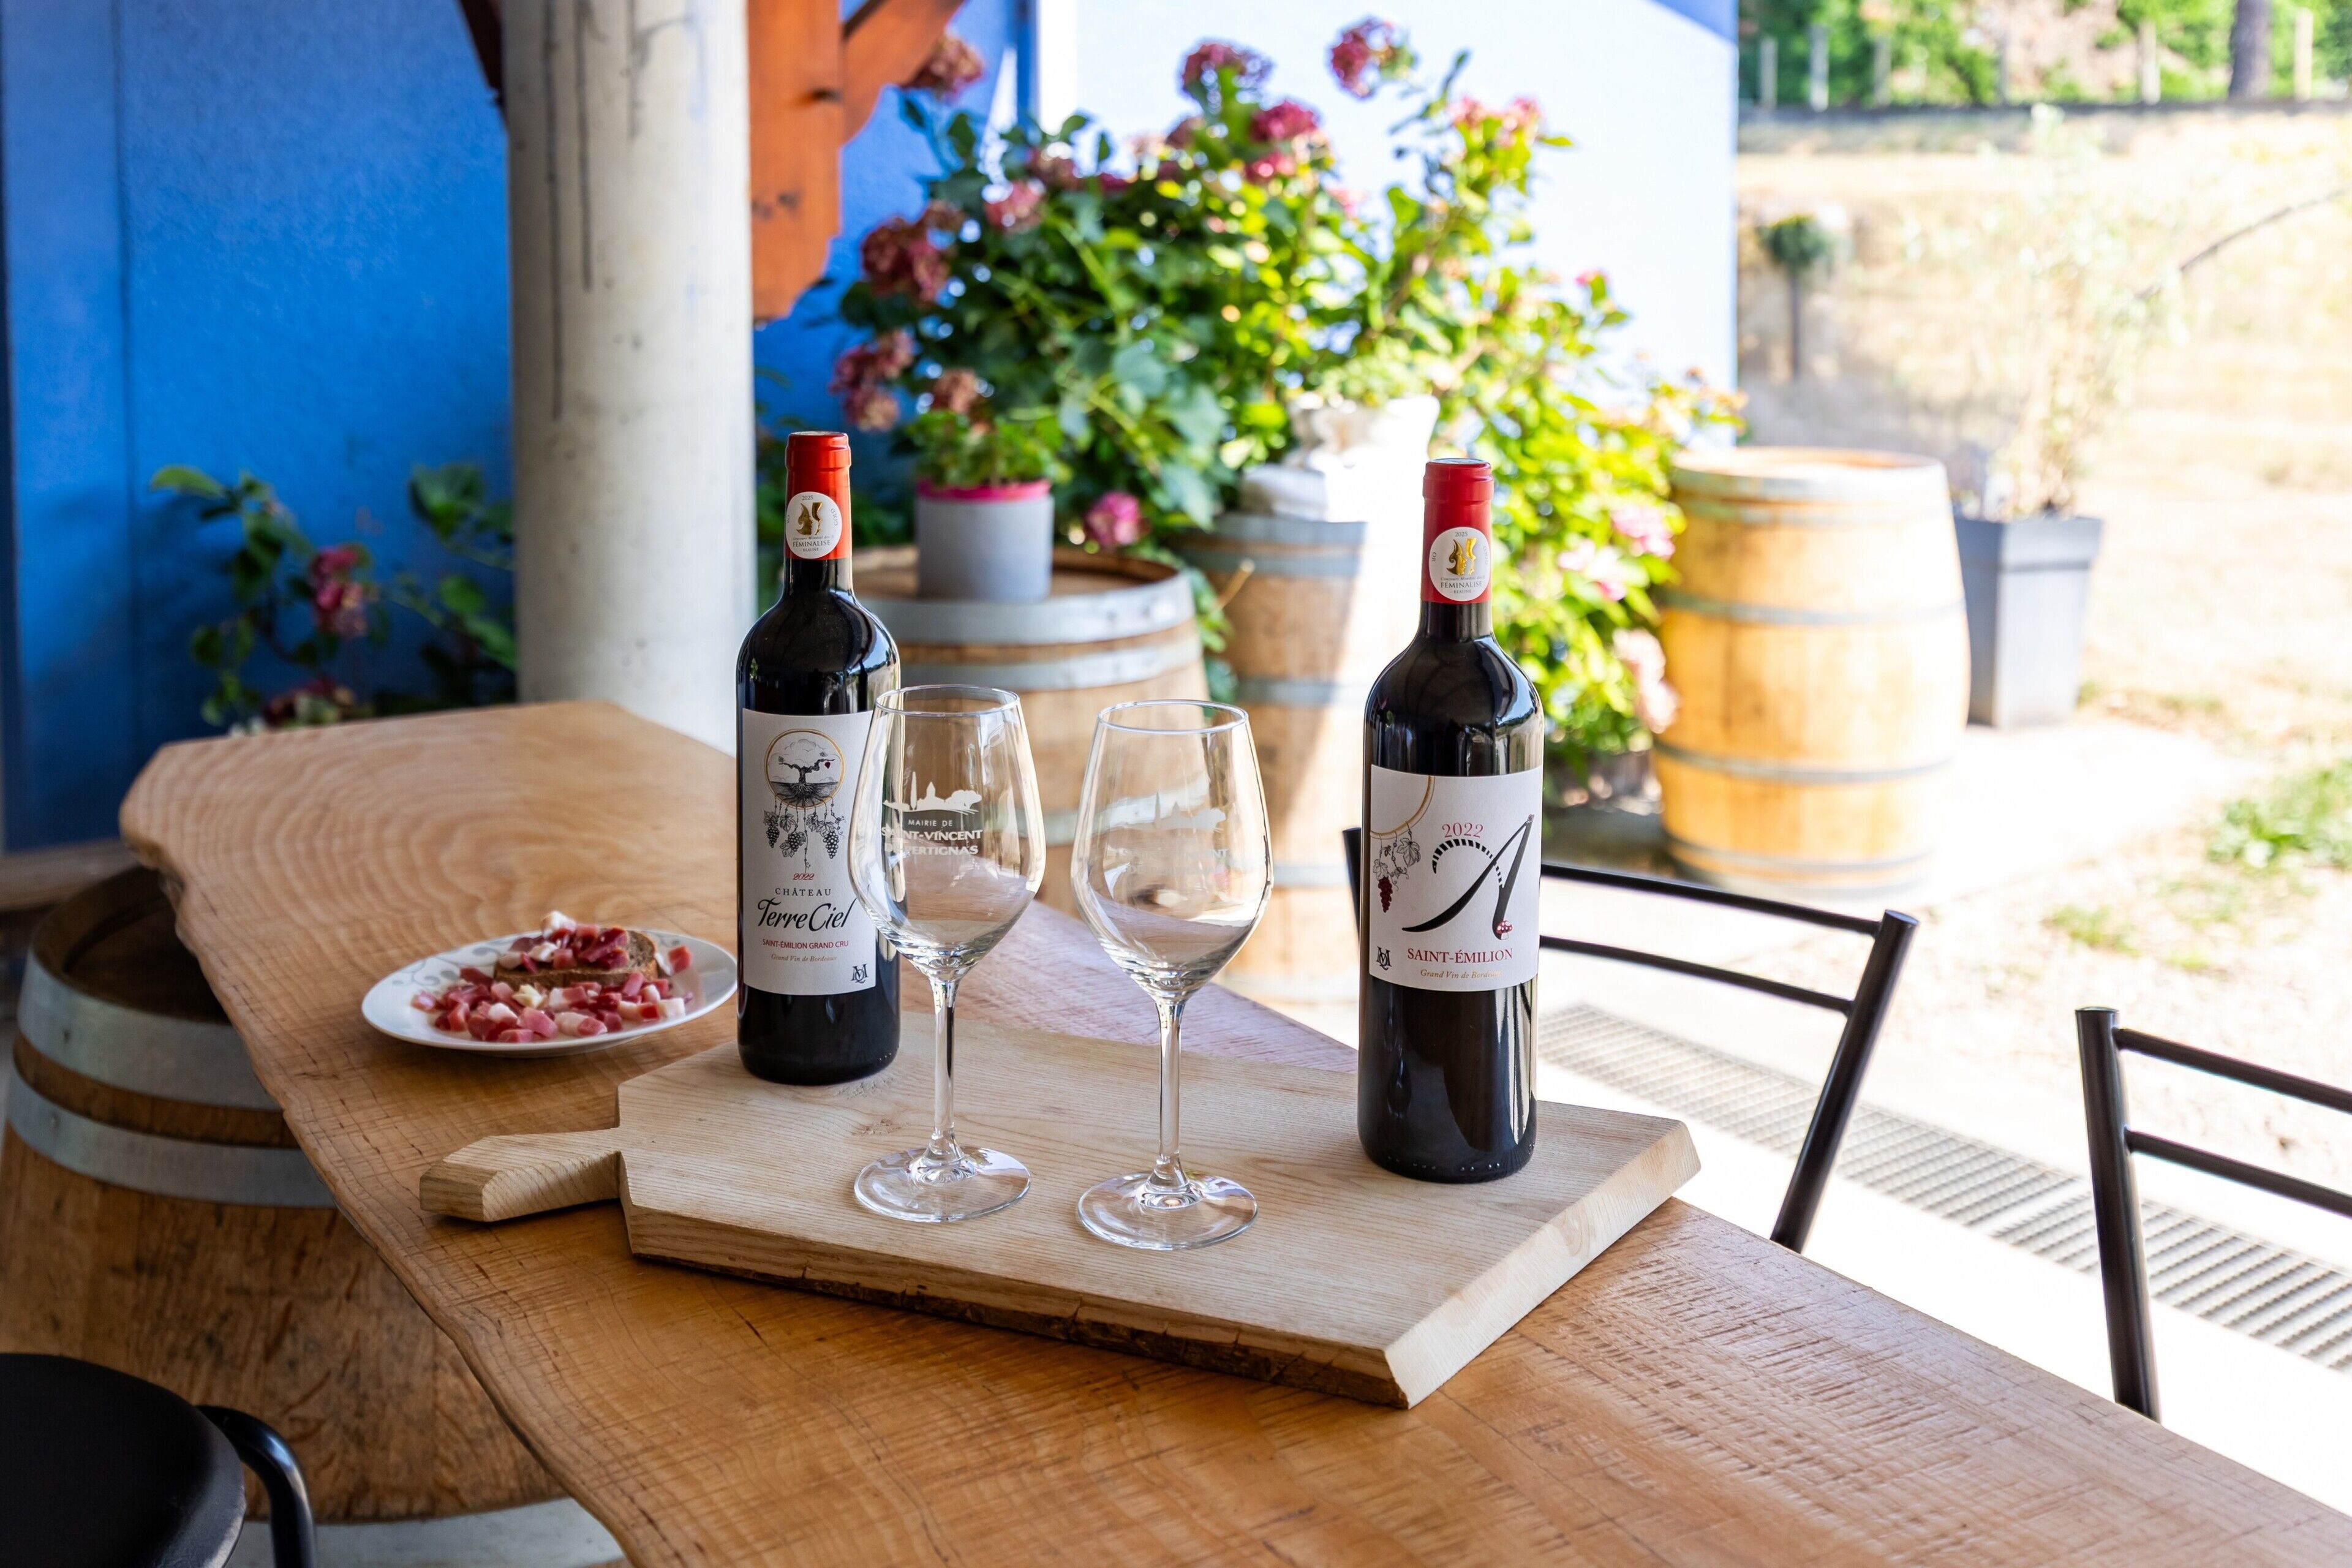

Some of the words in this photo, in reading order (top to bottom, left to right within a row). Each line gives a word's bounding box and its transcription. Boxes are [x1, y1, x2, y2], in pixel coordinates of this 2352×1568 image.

[881, 826, 983, 841] SANT-VINCENT
[1442, 822, 1484, 839] 2022
[793, 872, 815, 881] 2022
[775, 888, 832, 897] CHÂTEAU
[757, 897, 809, 929] Terre
[809, 897, 858, 932] Ciel
[762, 938, 808, 949] SAINT-ÉMILION
[1407, 948, 1513, 964] SAINT-ÉMILION
[1420, 969, 1444, 979] Grand
